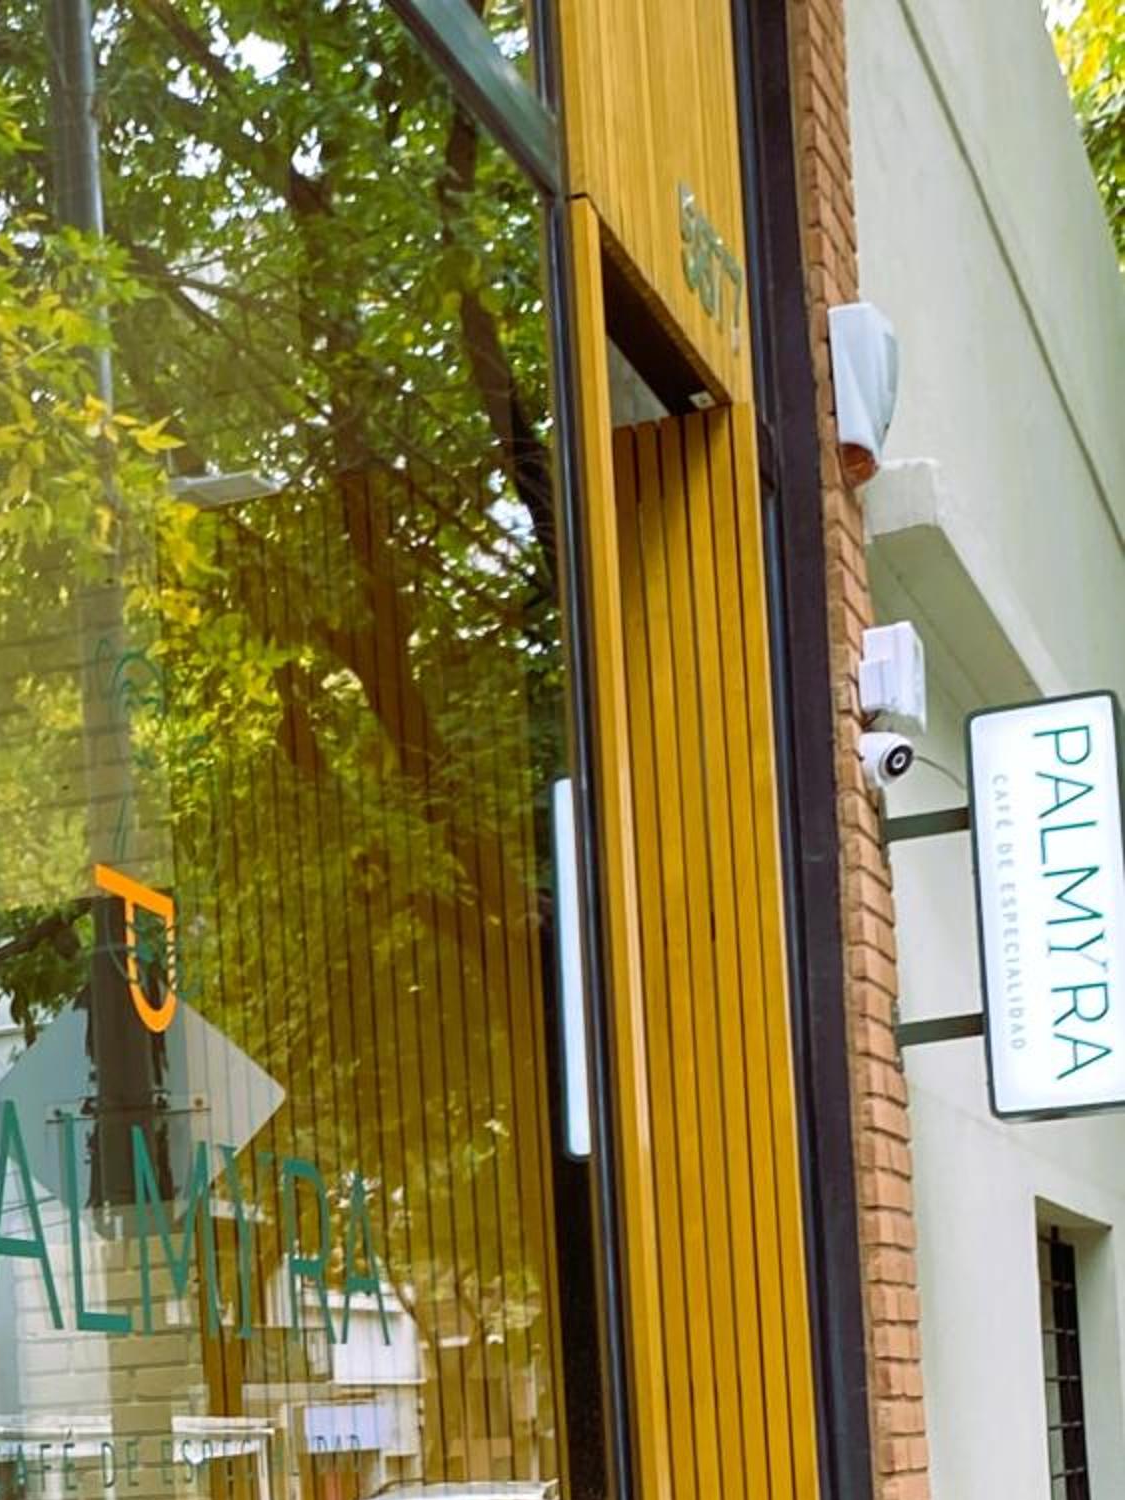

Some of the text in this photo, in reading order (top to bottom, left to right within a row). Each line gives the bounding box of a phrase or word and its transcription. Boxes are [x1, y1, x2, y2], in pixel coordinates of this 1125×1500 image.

[996, 842, 1015, 870] DE
[1032, 724, 1114, 1081] PALMYRA
[1000, 882, 1027, 1052] ESPECIALIDAD
[101, 1440, 141, 1489] DE
